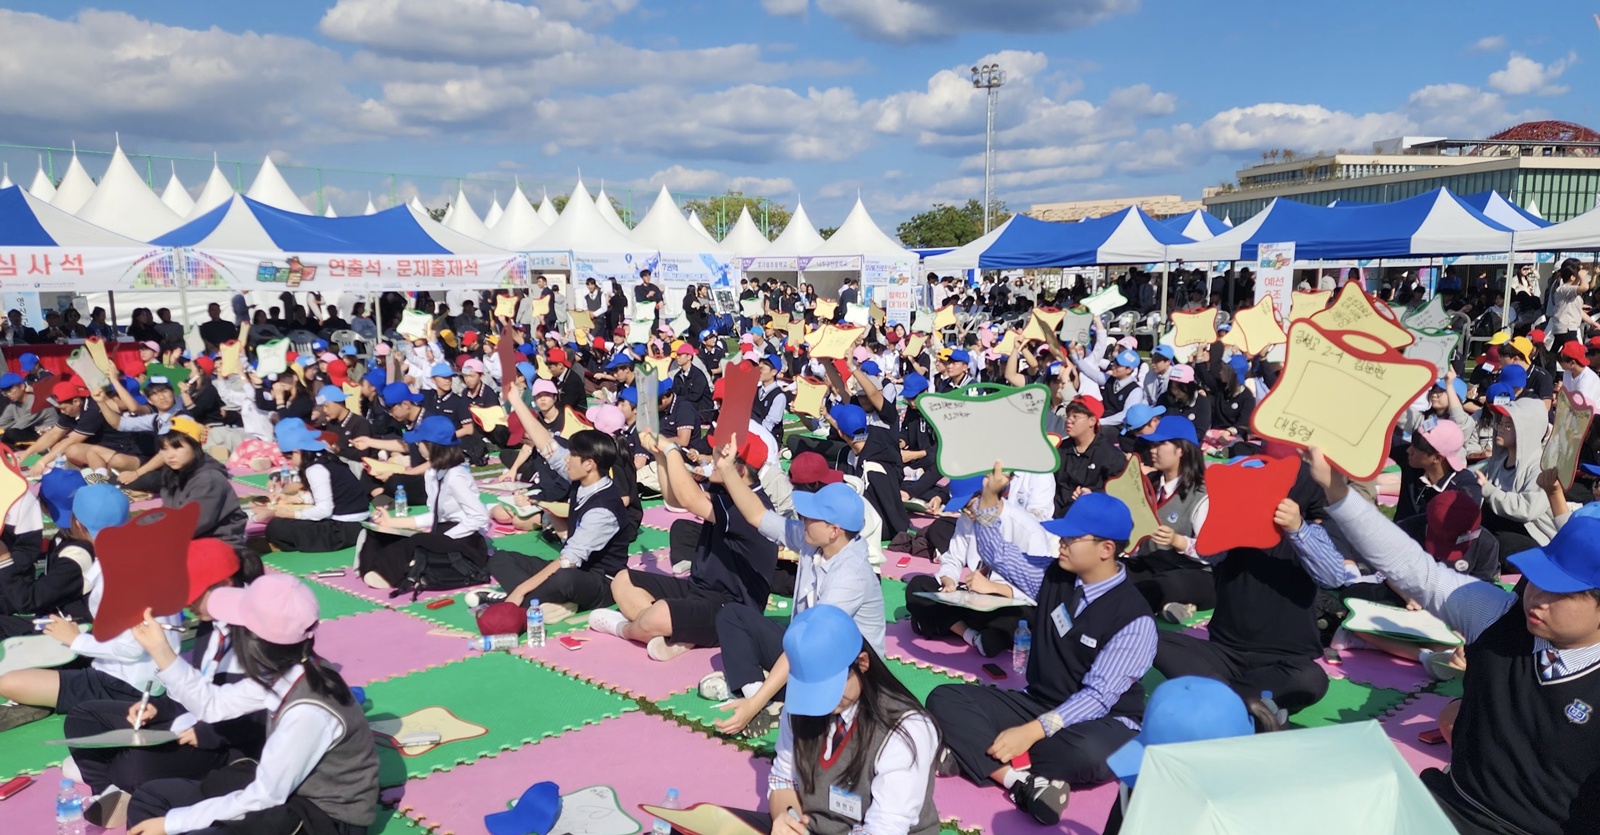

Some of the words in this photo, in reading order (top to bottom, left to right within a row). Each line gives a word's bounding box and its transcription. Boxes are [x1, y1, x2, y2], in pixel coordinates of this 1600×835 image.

[0, 253, 85, 276] 심사석
[328, 258, 383, 278] 연출석
[396, 258, 479, 278] 문제출제석
[661, 263, 679, 271] 7권역
[1264, 276, 1285, 286] 예선
[888, 291, 908, 299] 탈락자
[888, 300, 909, 309] 대기석
[1274, 416, 1315, 442] 대통령
